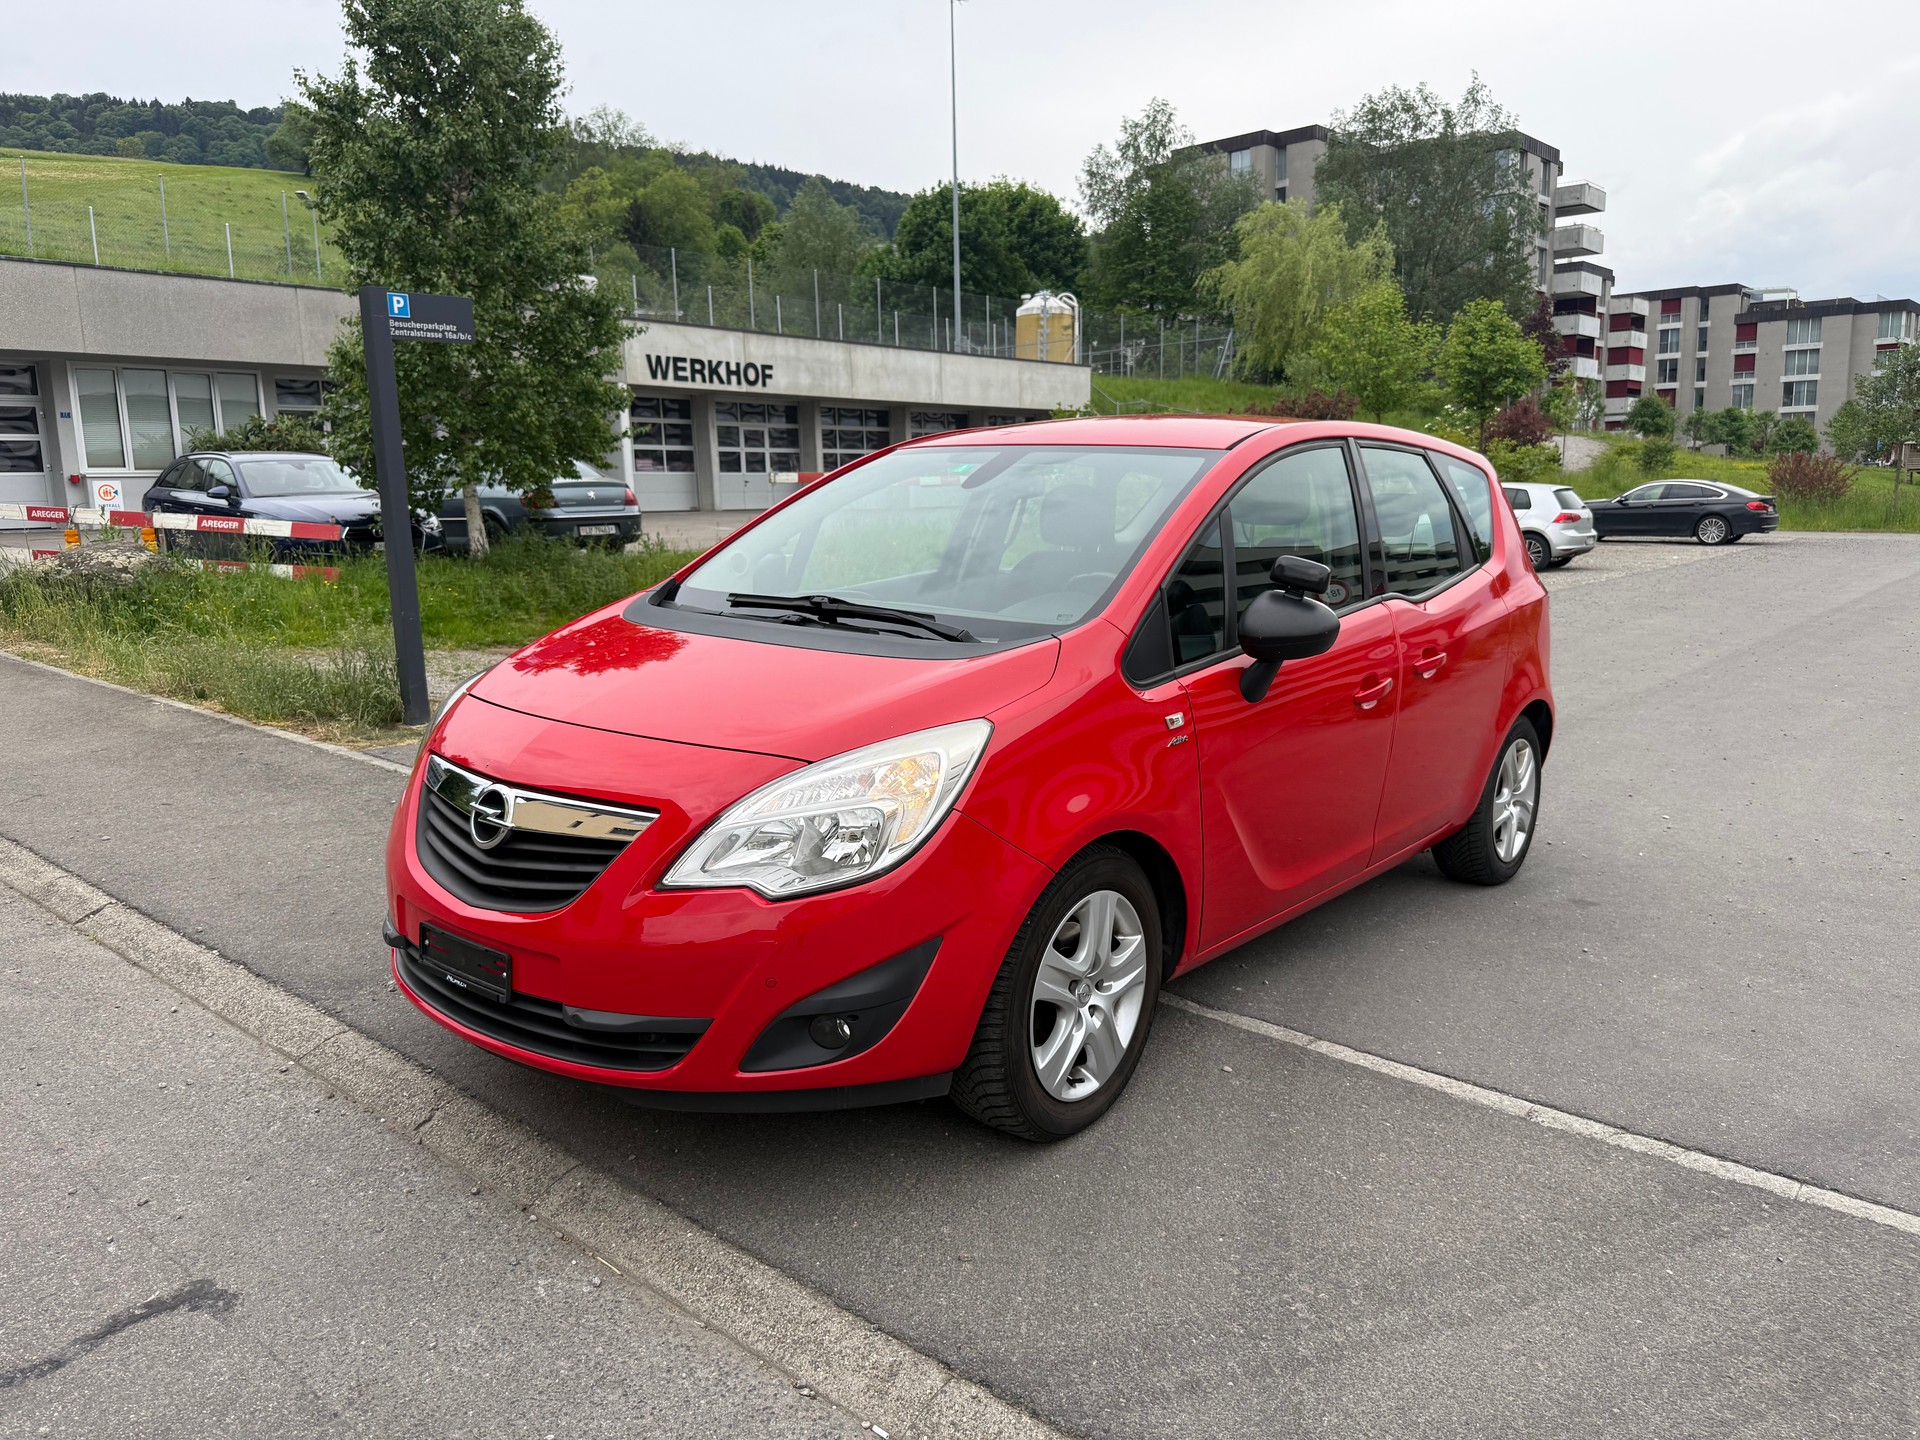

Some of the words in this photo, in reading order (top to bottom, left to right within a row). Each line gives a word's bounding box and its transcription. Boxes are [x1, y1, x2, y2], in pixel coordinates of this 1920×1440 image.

[393, 296, 404, 314] P
[389, 320, 457, 331] Besucherparkplatz
[390, 328, 443, 338] Zentralstrasse
[444, 331, 472, 340] 16a/b/c
[645, 354, 773, 387] WERKHOF
[31, 510, 65, 519] AREGGER
[201, 519, 239, 529] AREGGER
